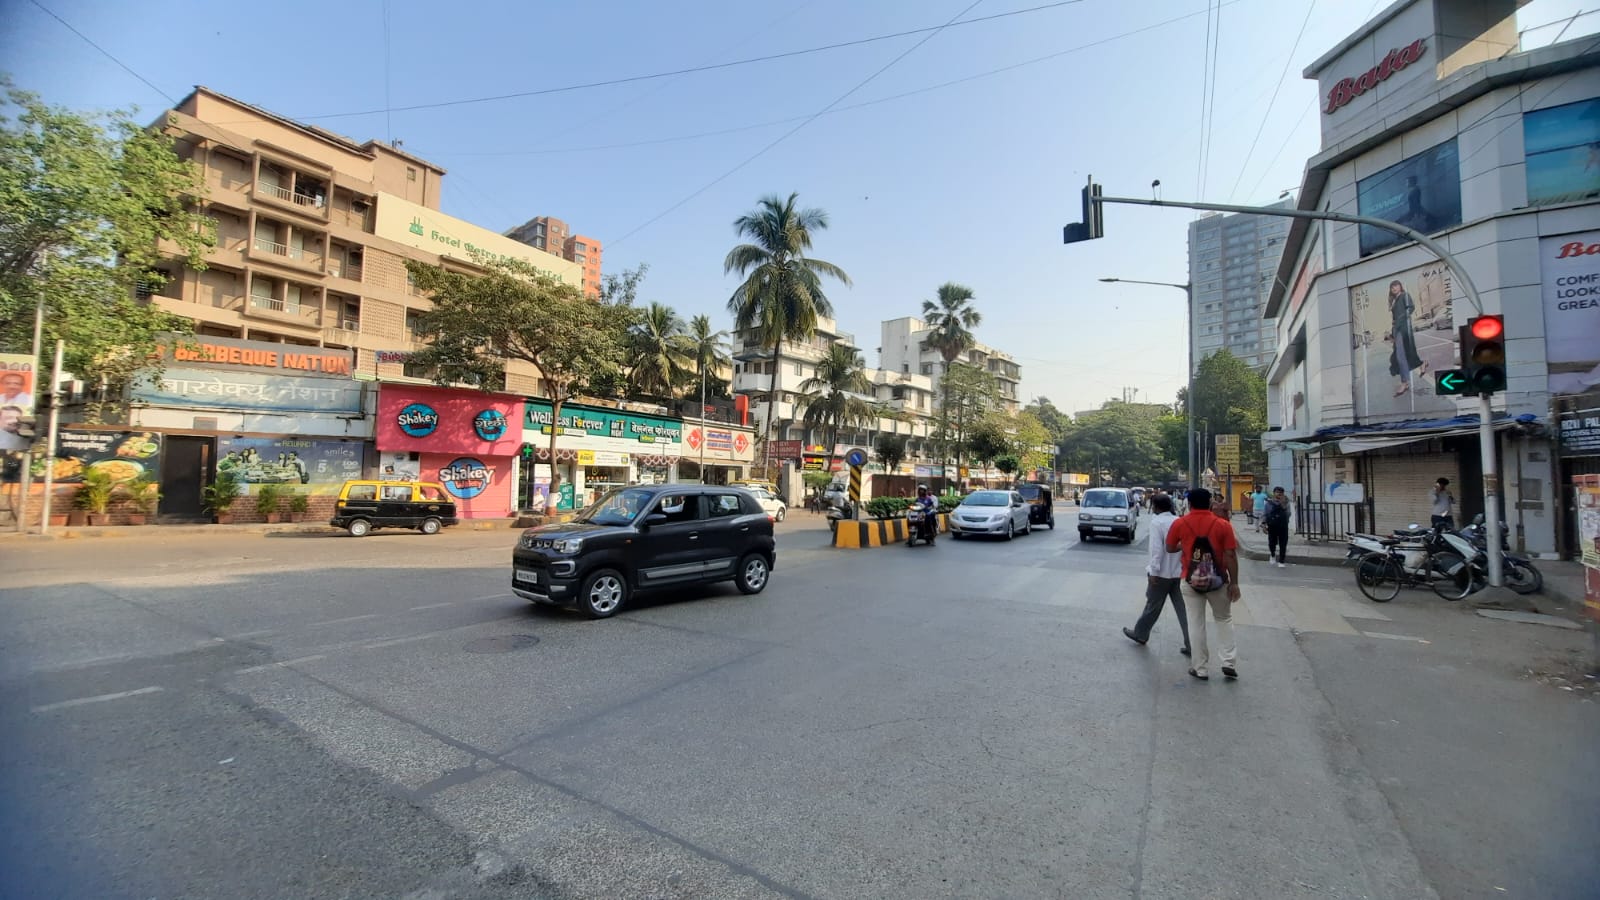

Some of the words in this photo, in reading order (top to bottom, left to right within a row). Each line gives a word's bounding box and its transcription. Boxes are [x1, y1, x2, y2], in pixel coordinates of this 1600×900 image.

[1324, 39, 1426, 114] Bata
[431, 230, 461, 249] Hotel
[1557, 286, 1600, 299] LOOK
[282, 353, 351, 375] NATION
[397, 411, 439, 426] Shakey
[530, 410, 570, 427] Welless
[572, 415, 604, 430] Forever
[440, 465, 494, 484] Shakey
